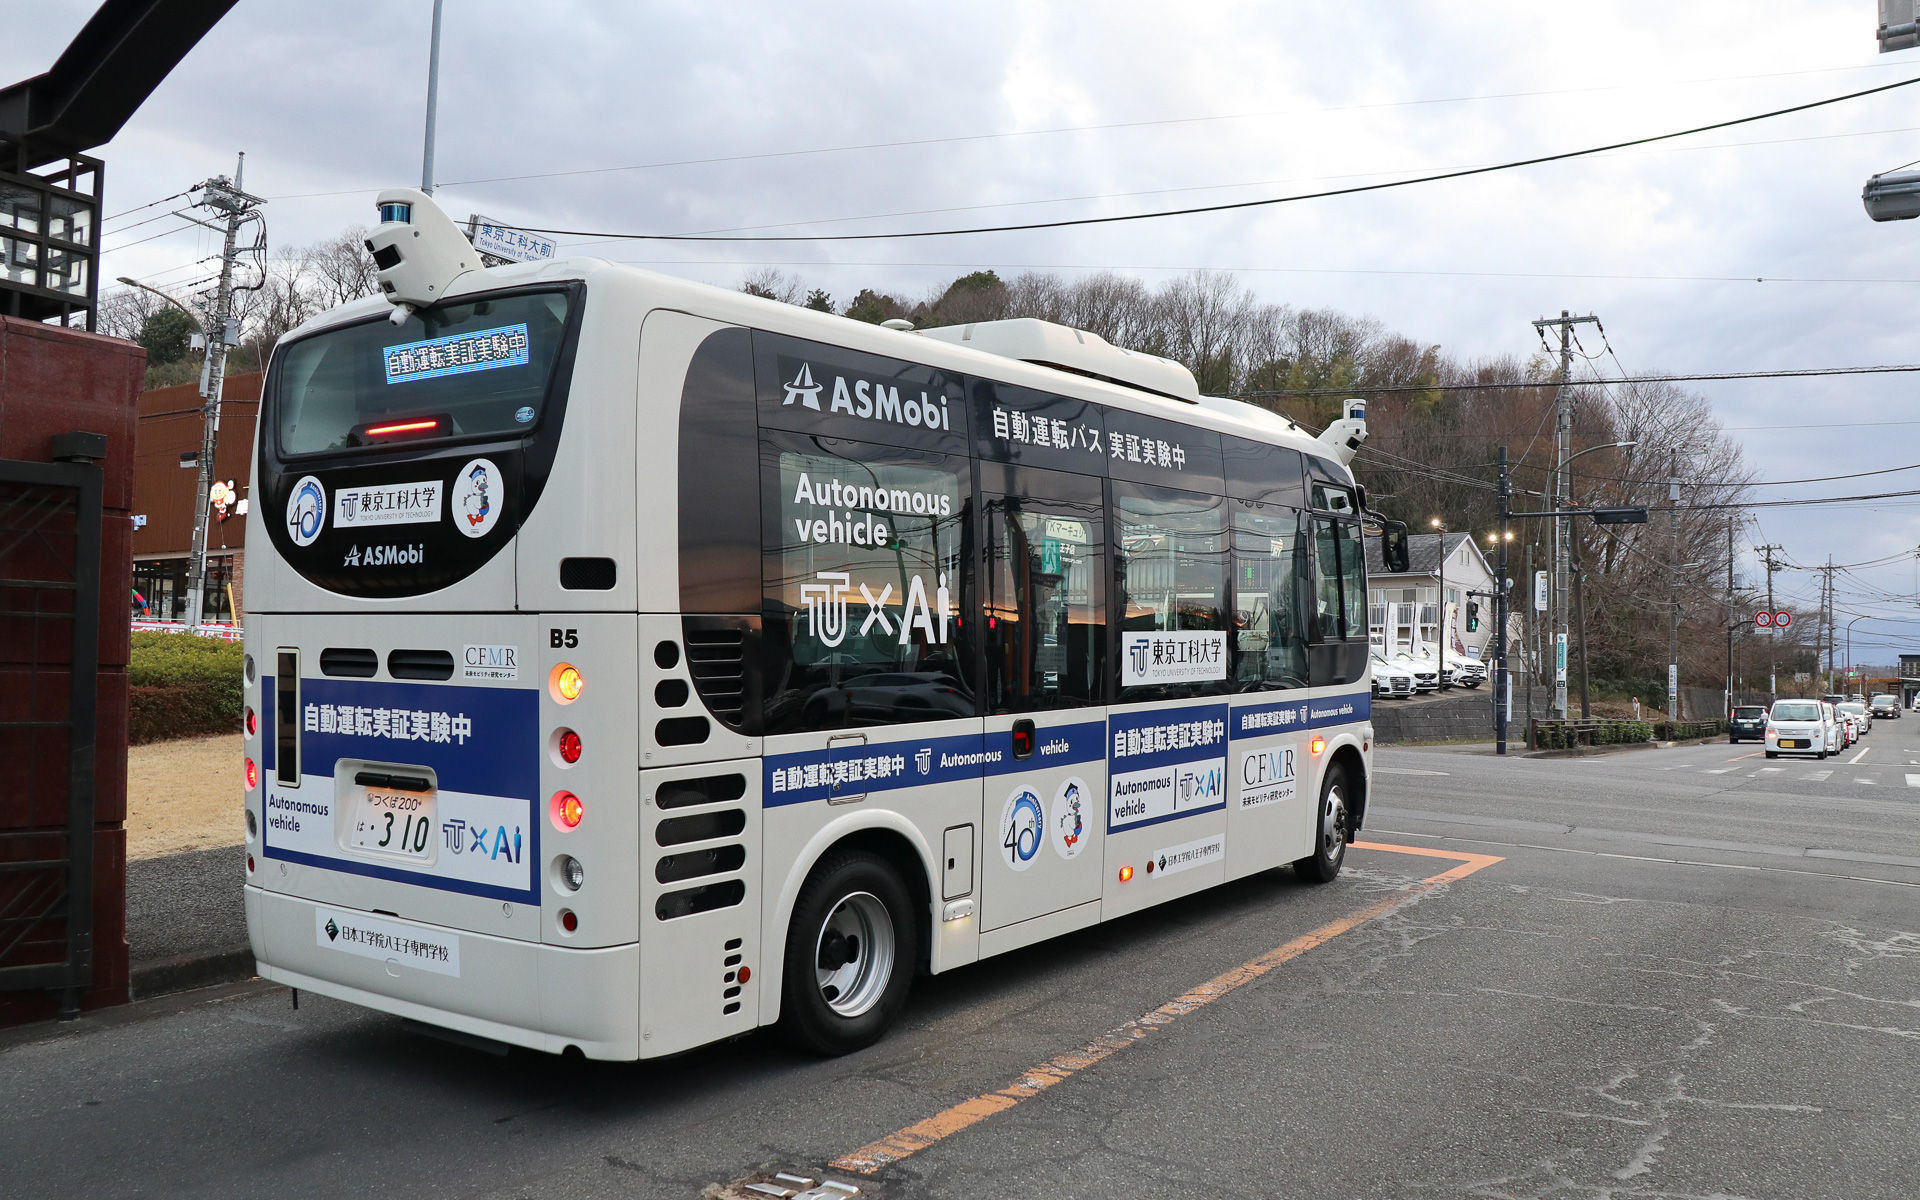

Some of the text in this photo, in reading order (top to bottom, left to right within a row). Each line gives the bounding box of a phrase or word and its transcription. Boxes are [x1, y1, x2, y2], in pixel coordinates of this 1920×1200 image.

[480, 237, 493, 249] Tokyo
[494, 242, 516, 257] University
[481, 222, 552, 257] 東京工科大前
[388, 331, 526, 377] 自動運転実証実験中
[830, 376, 950, 431] ASMobi
[993, 407, 1186, 471] 自動運転バス 実証実験中
[361, 487, 435, 512] 東京工科大学
[794, 472, 950, 516] Autonomous
[361, 514, 374, 522] TOKYO
[374, 513, 398, 521] UNIVERSITY
[405, 510, 434, 519] TECHNOLOGY
[794, 510, 888, 546] vehicle
[363, 543, 424, 566] ASMobi
[1778, 615, 1788, 623] 40
[549, 628, 579, 649] B5
[465, 647, 516, 666] CFMR
[1152, 638, 1221, 665] 東京工科大学
[465, 670, 515, 679] 未来モビリティ研究センター
[1152, 666, 1221, 677] TOKYO UNIVERSITY OF TECHNOLOGY
[1242, 709, 1297, 730] 自動運転実証実験中
[1310, 703, 1354, 719] Autonomous vehicle
[304, 702, 472, 745] 自動運転実証実験中
[1114, 719, 1224, 758] 自動運転実証実験中
[940, 738, 1069, 768] Autonomous vehicle
[772, 756, 905, 793] 自動運転実証実験中
[1243, 749, 1295, 785] CFMR
[1115, 777, 1171, 797] Autonomous
[268, 793, 329, 817] Autonomous
[1115, 798, 1146, 818] vehicle
[268, 815, 301, 833] vehicle
[342, 925, 449, 962] 日本工学院八王子専門学校
